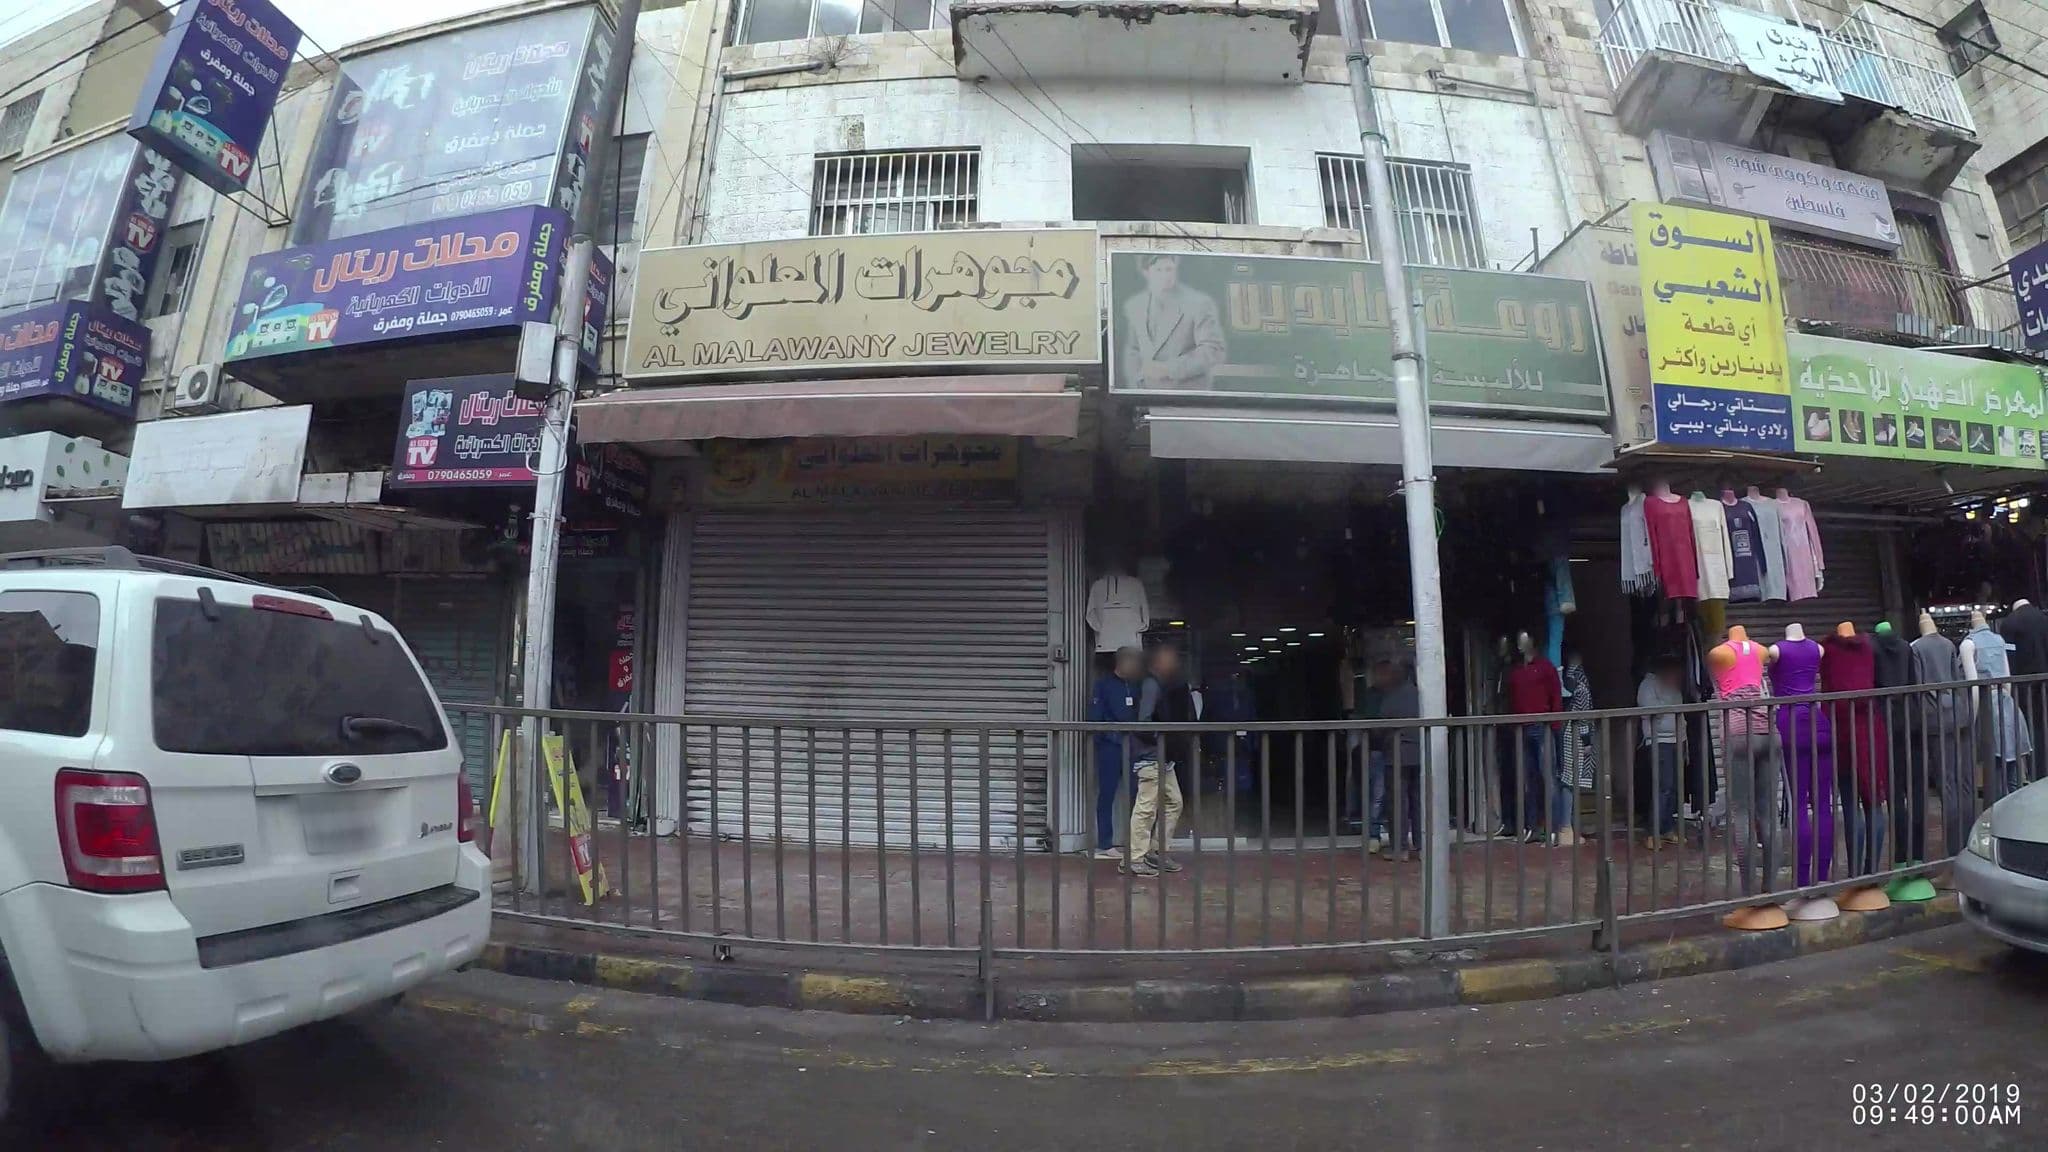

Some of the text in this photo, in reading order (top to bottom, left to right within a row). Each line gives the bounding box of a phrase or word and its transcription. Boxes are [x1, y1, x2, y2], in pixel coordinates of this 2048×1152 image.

[200, 48, 255, 96] جملة ومفرق
[221, 148, 249, 177] TV
[1785, 191, 1847, 218] فلسطين
[127, 222, 154, 248] TV
[1649, 212, 1764, 256] السوق
[402, 231, 520, 272] محلات
[313, 249, 399, 293] ريتال
[523, 222, 555, 312] جملة ومفرق
[855, 245, 1080, 312] مجوهرات
[1653, 267, 1772, 304] الشعبي
[308, 319, 337, 340] TV
[373, 315, 413, 334] ومفرق
[416, 311, 447, 326] جملة
[1682, 312, 1736, 336] قطعة
[54, 312, 82, 382] جملة ومفرق
[642, 331, 1081, 368] AL MALAWANY JEWELRY
[1658, 345, 1707, 374] وأكثر
[101, 361, 123, 380] TV
[1294, 353, 1394, 391] جاهزة
[1710, 354, 1783, 382] بدينارين
[458, 391, 501, 425] ريتال
[1667, 393, 1717, 412] رجالي
[1981, 387, 2044, 419] لمعرض
[1669, 420, 1704, 434] بيبي
[1714, 419, 1748, 437] بناتي
[408, 447, 437, 464] TV
[427, 469, 493, 480] 0790465059
